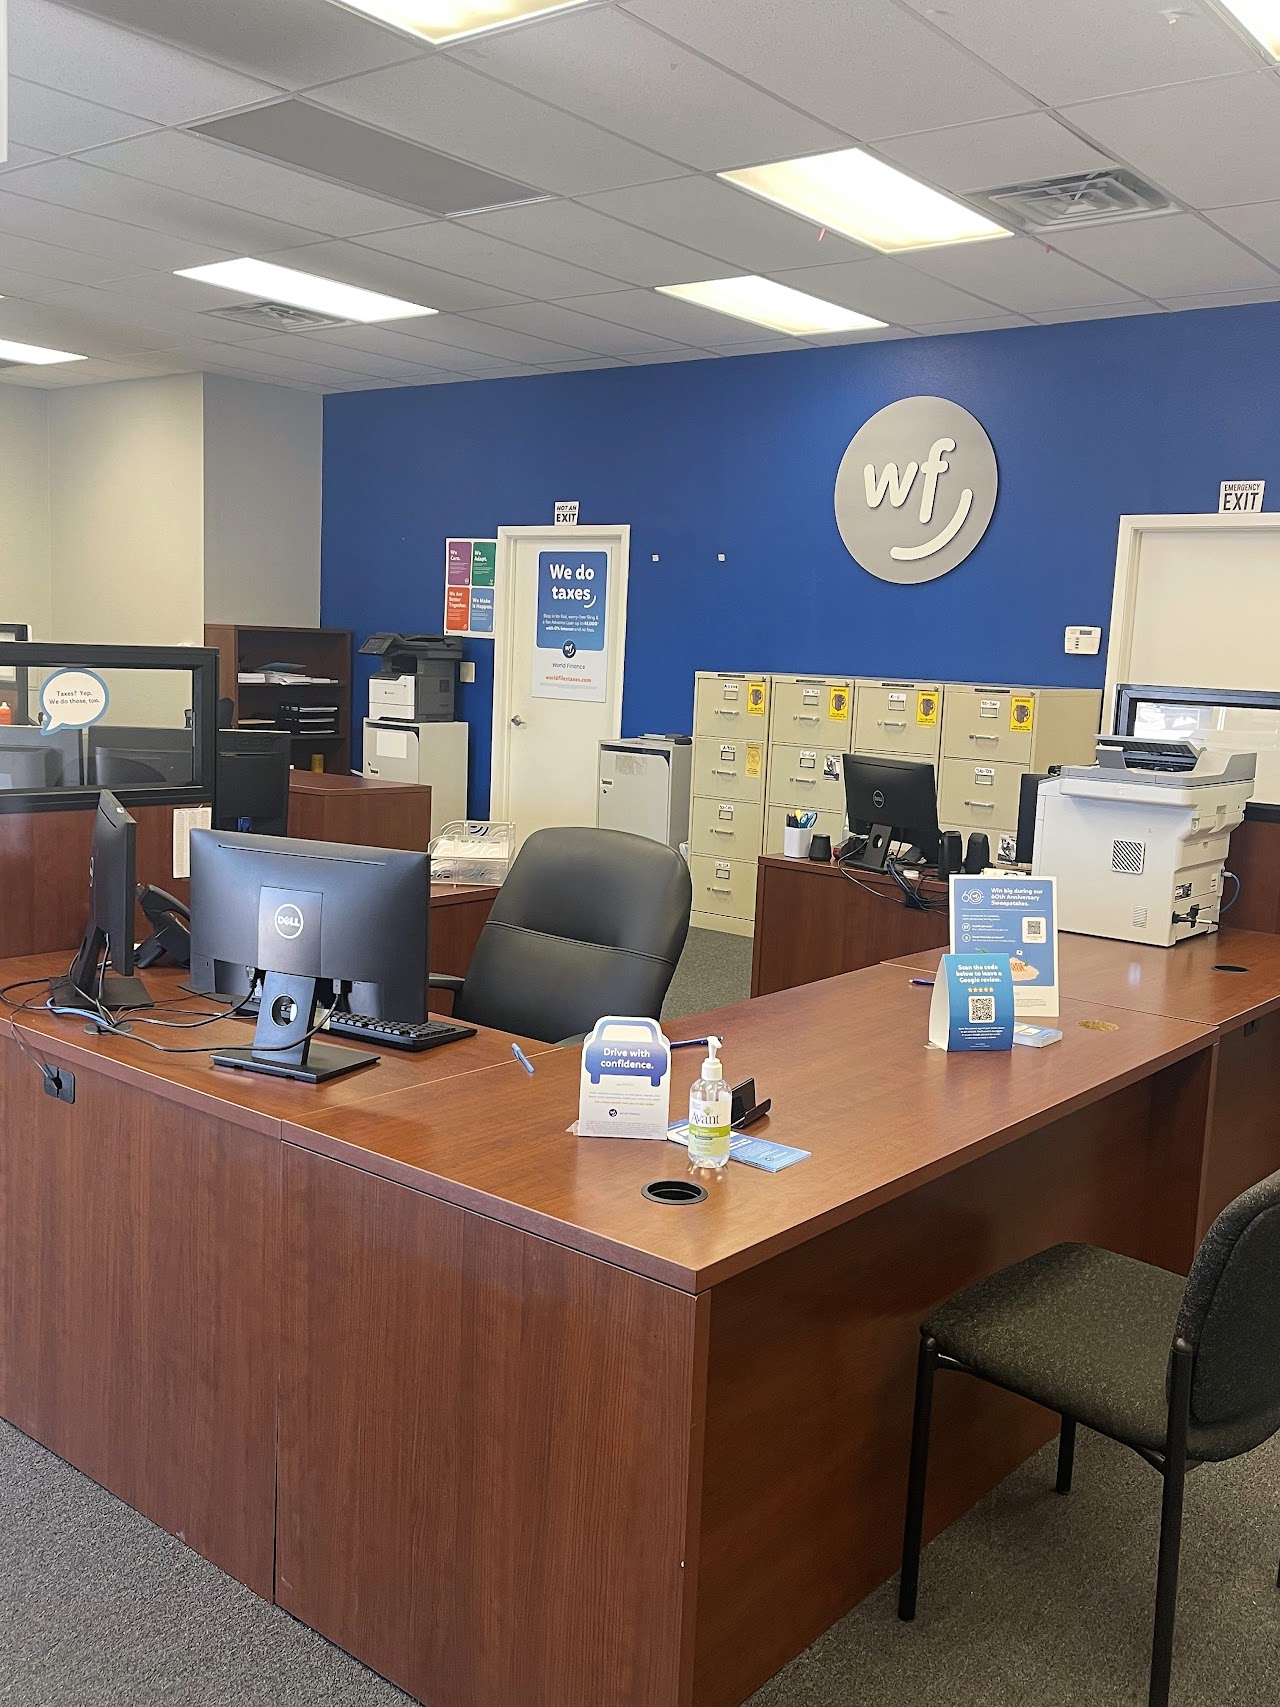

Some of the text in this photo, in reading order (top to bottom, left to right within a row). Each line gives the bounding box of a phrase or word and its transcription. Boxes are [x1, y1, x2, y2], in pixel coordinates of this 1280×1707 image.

[863, 437, 956, 524] wf
[1224, 483, 1261, 492] EMERGENCY
[1223, 492, 1259, 511] EXIT
[556, 513, 577, 523] EXIT
[549, 563, 595, 580] We do
[551, 585, 591, 600] taxes
[1003, 888, 1013, 896] big
[1013, 888, 1033, 896] during
[1006, 894, 1040, 902] Anniversary
[277, 915, 301, 927] DELL
[959, 976, 980, 984] Google
[603, 1047, 651, 1058] Drive with
[600, 1058, 655, 1070] confidence.
[691, 1112, 720, 1125] Avant
